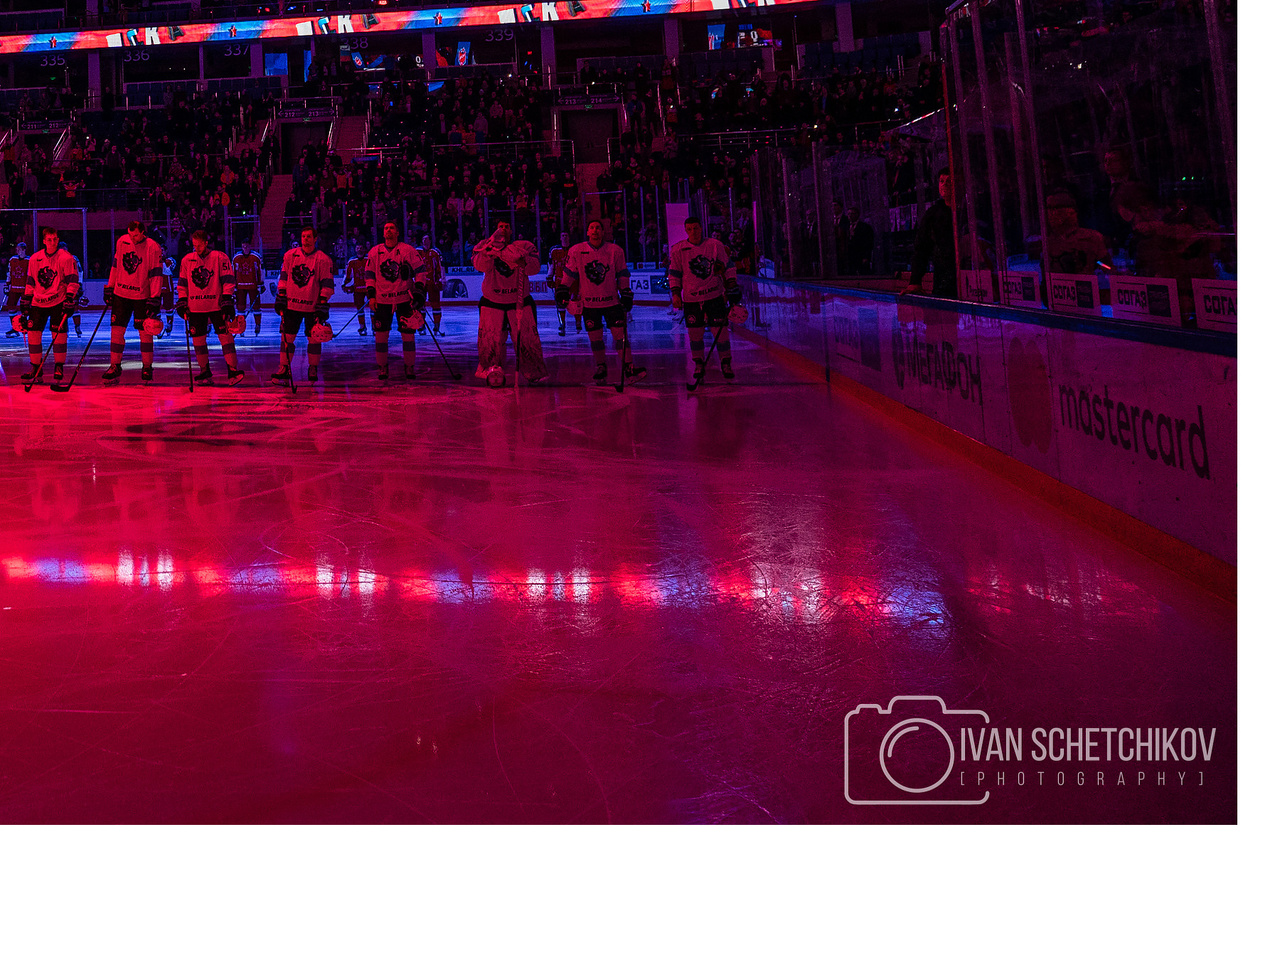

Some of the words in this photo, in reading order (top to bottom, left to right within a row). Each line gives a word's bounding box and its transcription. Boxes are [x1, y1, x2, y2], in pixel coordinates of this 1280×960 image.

[484, 29, 514, 42] 339
[123, 50, 150, 62] 336
[224, 42, 250, 57] 337
[40, 55, 66, 68] 335
[1053, 284, 1076, 301] СОГАЗ
[1118, 289, 1147, 308] СОГАЗ
[1204, 294, 1237, 315] СОГА
[1058, 384, 1210, 480] mastercard
